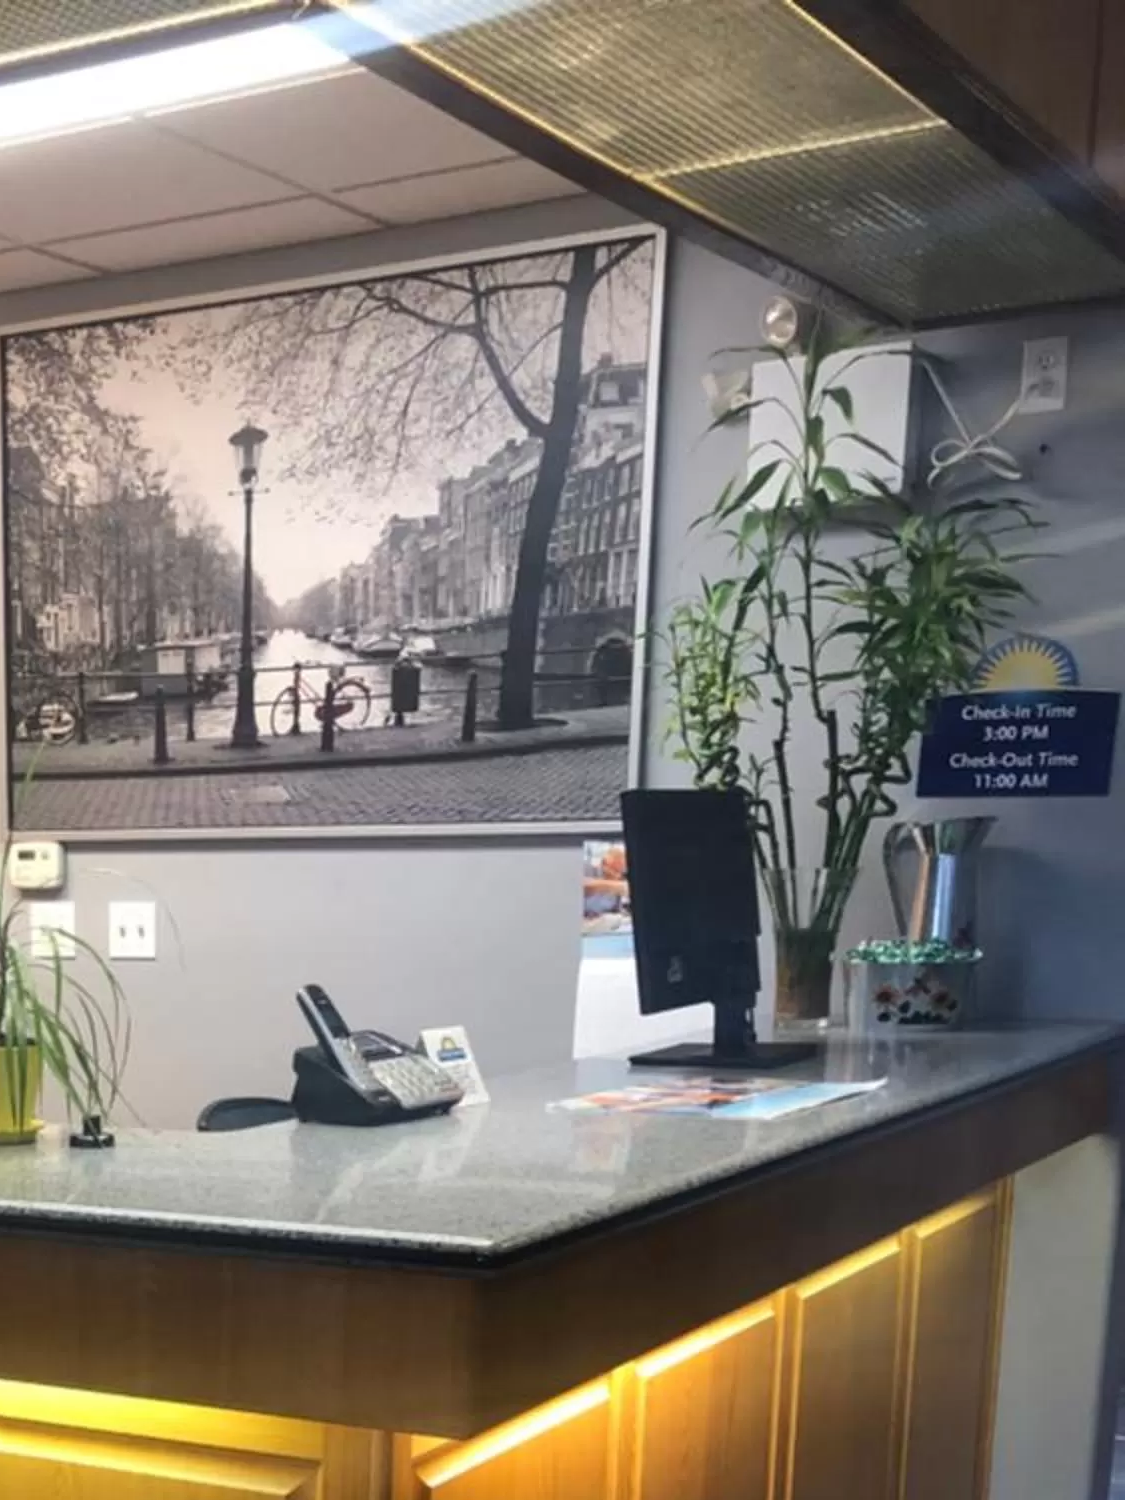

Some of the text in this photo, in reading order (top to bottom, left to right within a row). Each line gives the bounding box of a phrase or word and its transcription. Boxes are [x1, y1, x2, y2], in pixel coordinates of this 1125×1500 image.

[961, 703, 1077, 721] Check-In Time
[983, 725, 1050, 741] 3:00 PM
[949, 751, 1079, 769] Check-Out Time
[974, 773, 1049, 789] 11:00 AM
